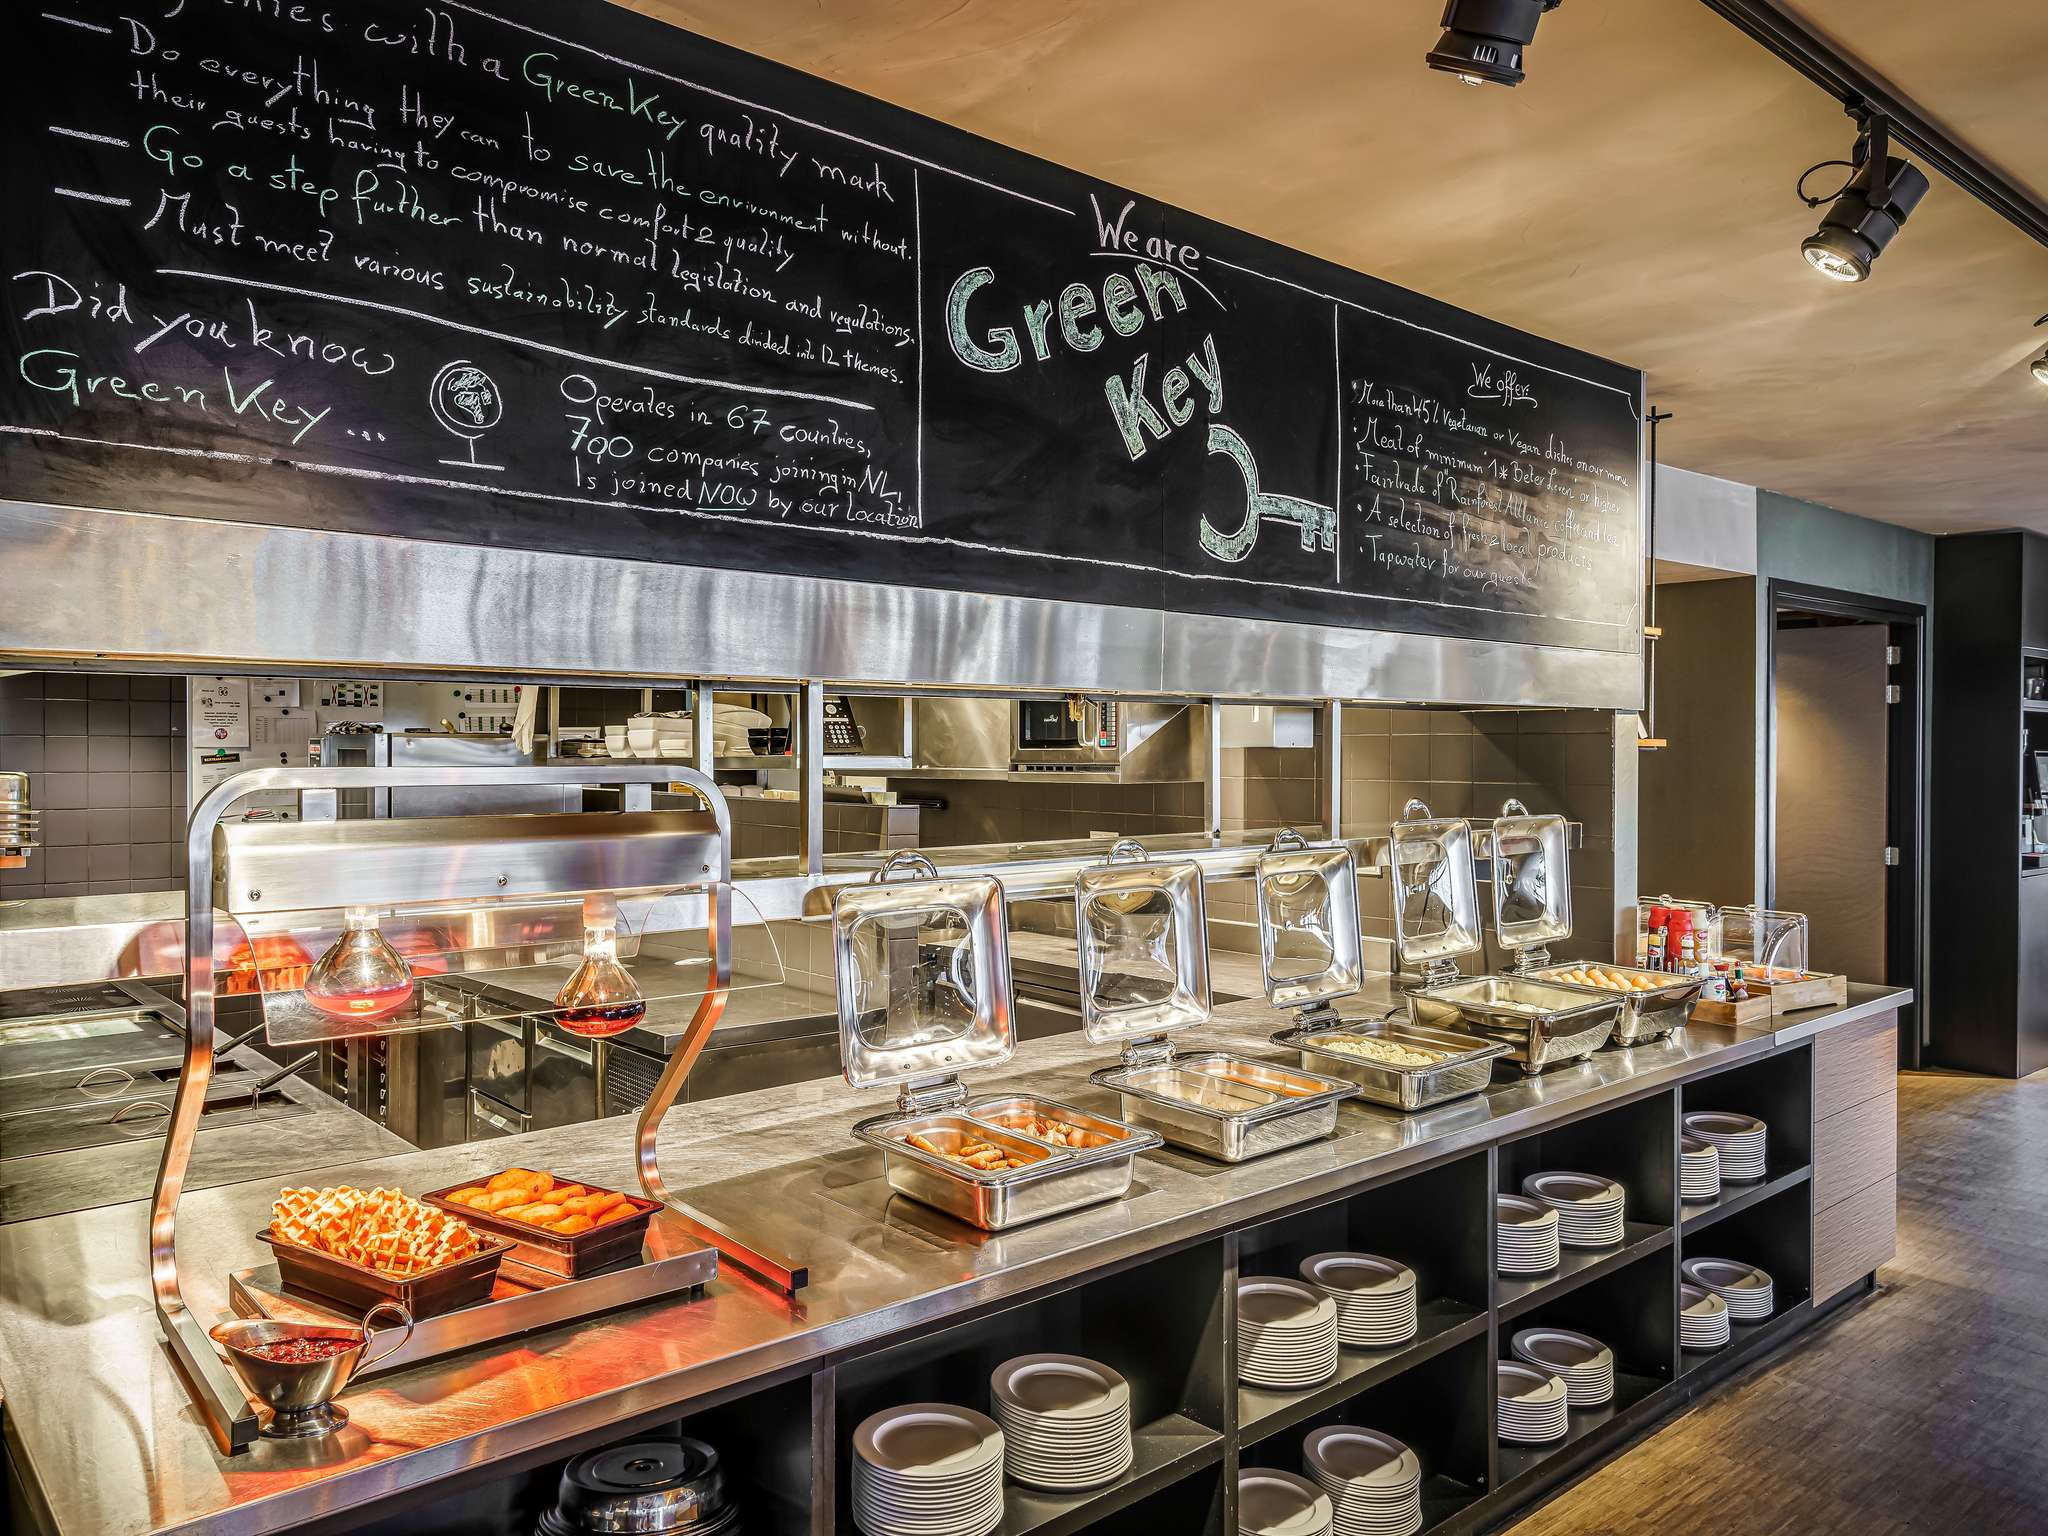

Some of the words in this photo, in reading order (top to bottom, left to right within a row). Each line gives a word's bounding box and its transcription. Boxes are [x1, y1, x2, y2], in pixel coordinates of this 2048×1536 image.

[119, 16, 180, 61] Do
[400, 84, 456, 138] they
[460, 130, 500, 151] can
[521, 110, 551, 162] to
[568, 152, 644, 186] save
[646, 148, 691, 197] the
[364, 7, 467, 66] with
[482, 57, 510, 81] a
[523, 52, 624, 103] Green
[629, 77, 687, 140] Key
[700, 115, 799, 177] quality
[812, 158, 894, 203] mark
[131, 70, 206, 112] their
[211, 106, 312, 140] guests
[329, 117, 407, 173] having
[413, 140, 439, 170] to
[450, 164, 589, 214] compromise
[724, 227, 795, 273] quality
[143, 124, 203, 177] Go
[228, 163, 254, 182] a
[269, 154, 339, 218] step
[351, 168, 464, 225] further
[472, 195, 544, 246] than
[562, 234, 658, 271] normal
[671, 247, 777, 303] legislation
[785, 295, 823, 319] and
[1090, 192, 1141, 250] We
[1145, 236, 1201, 272] are
[143, 188, 246, 246] Must
[254, 229, 335, 262] meet
[354, 250, 446, 291] various
[466, 263, 629, 330] sustainability
[636, 291, 731, 340] standards
[12, 270, 134, 325] Did
[133, 311, 237, 355] you
[246, 297, 396, 377] know
[945, 261, 1188, 374] Green
[18, 348, 206, 407] Green
[560, 374, 675, 426] Operates
[690, 402, 713, 426] in
[726, 404, 772, 435] 67
[1104, 333, 1224, 462] Key
[1471, 361, 1492, 389] We
[646, 445, 759, 477] companies
[1357, 379, 1385, 407] More
[1385, 388, 1413, 416] than
[1493, 431, 1505, 441] or
[1507, 427, 1541, 456] Vegan
[1545, 433, 1573, 467] dishes
[1357, 416, 1404, 451] Meat
[1406, 433, 1423, 459] of
[609, 470, 693, 500] joined
[768, 490, 793, 519] by
[800, 501, 840, 518] our
[1364, 492, 1382, 522] A
[1387, 497, 1441, 539] selection
[1443, 511, 1456, 550] of
[1364, 534, 1437, 571] Tapwater
[1442, 548, 1459, 579] for
[1463, 567, 1487, 580] our
